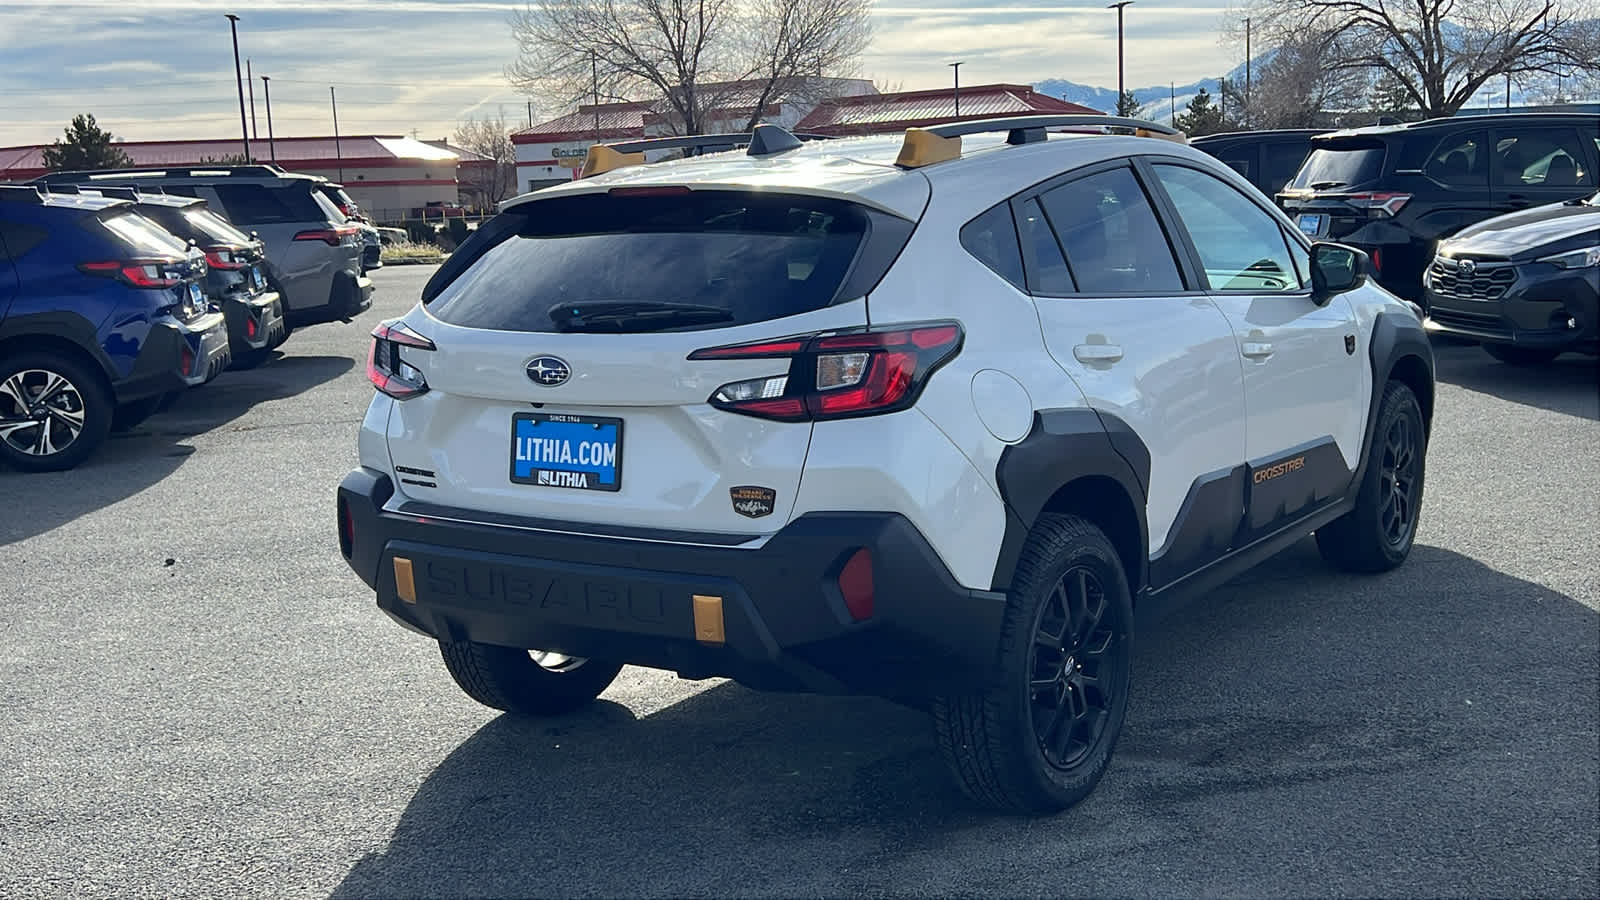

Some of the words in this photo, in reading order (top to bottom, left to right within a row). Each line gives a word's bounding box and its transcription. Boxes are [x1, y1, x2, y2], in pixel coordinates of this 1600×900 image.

[515, 436, 617, 468] LITHIA.COM
[549, 470, 588, 488] LITHIA
[1254, 456, 1305, 484] CROSSTREK
[425, 559, 665, 624] SUBARU
